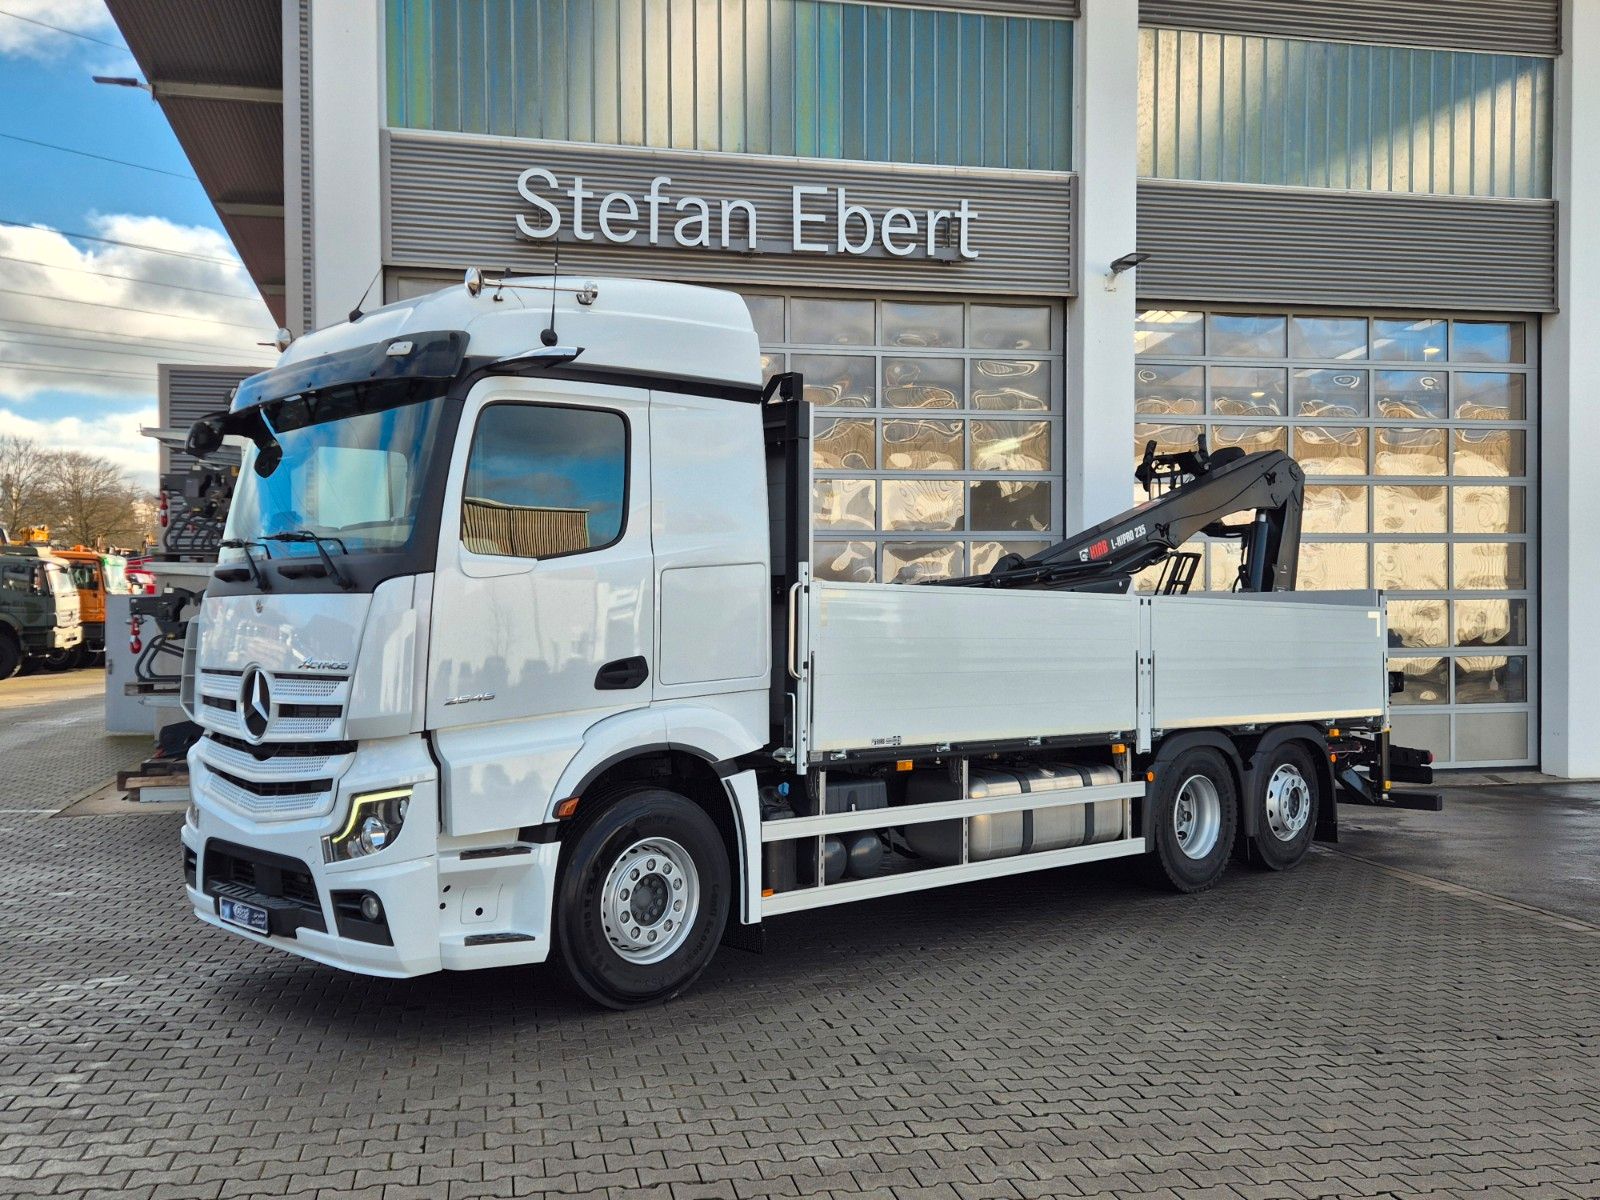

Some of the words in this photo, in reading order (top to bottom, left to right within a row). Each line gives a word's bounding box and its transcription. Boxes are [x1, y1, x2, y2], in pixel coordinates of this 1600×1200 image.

[514, 167, 758, 251] Stefan
[791, 185, 980, 260] Ebert
[1089, 540, 1108, 560] HIAB
[1134, 524, 1146, 537] 235
